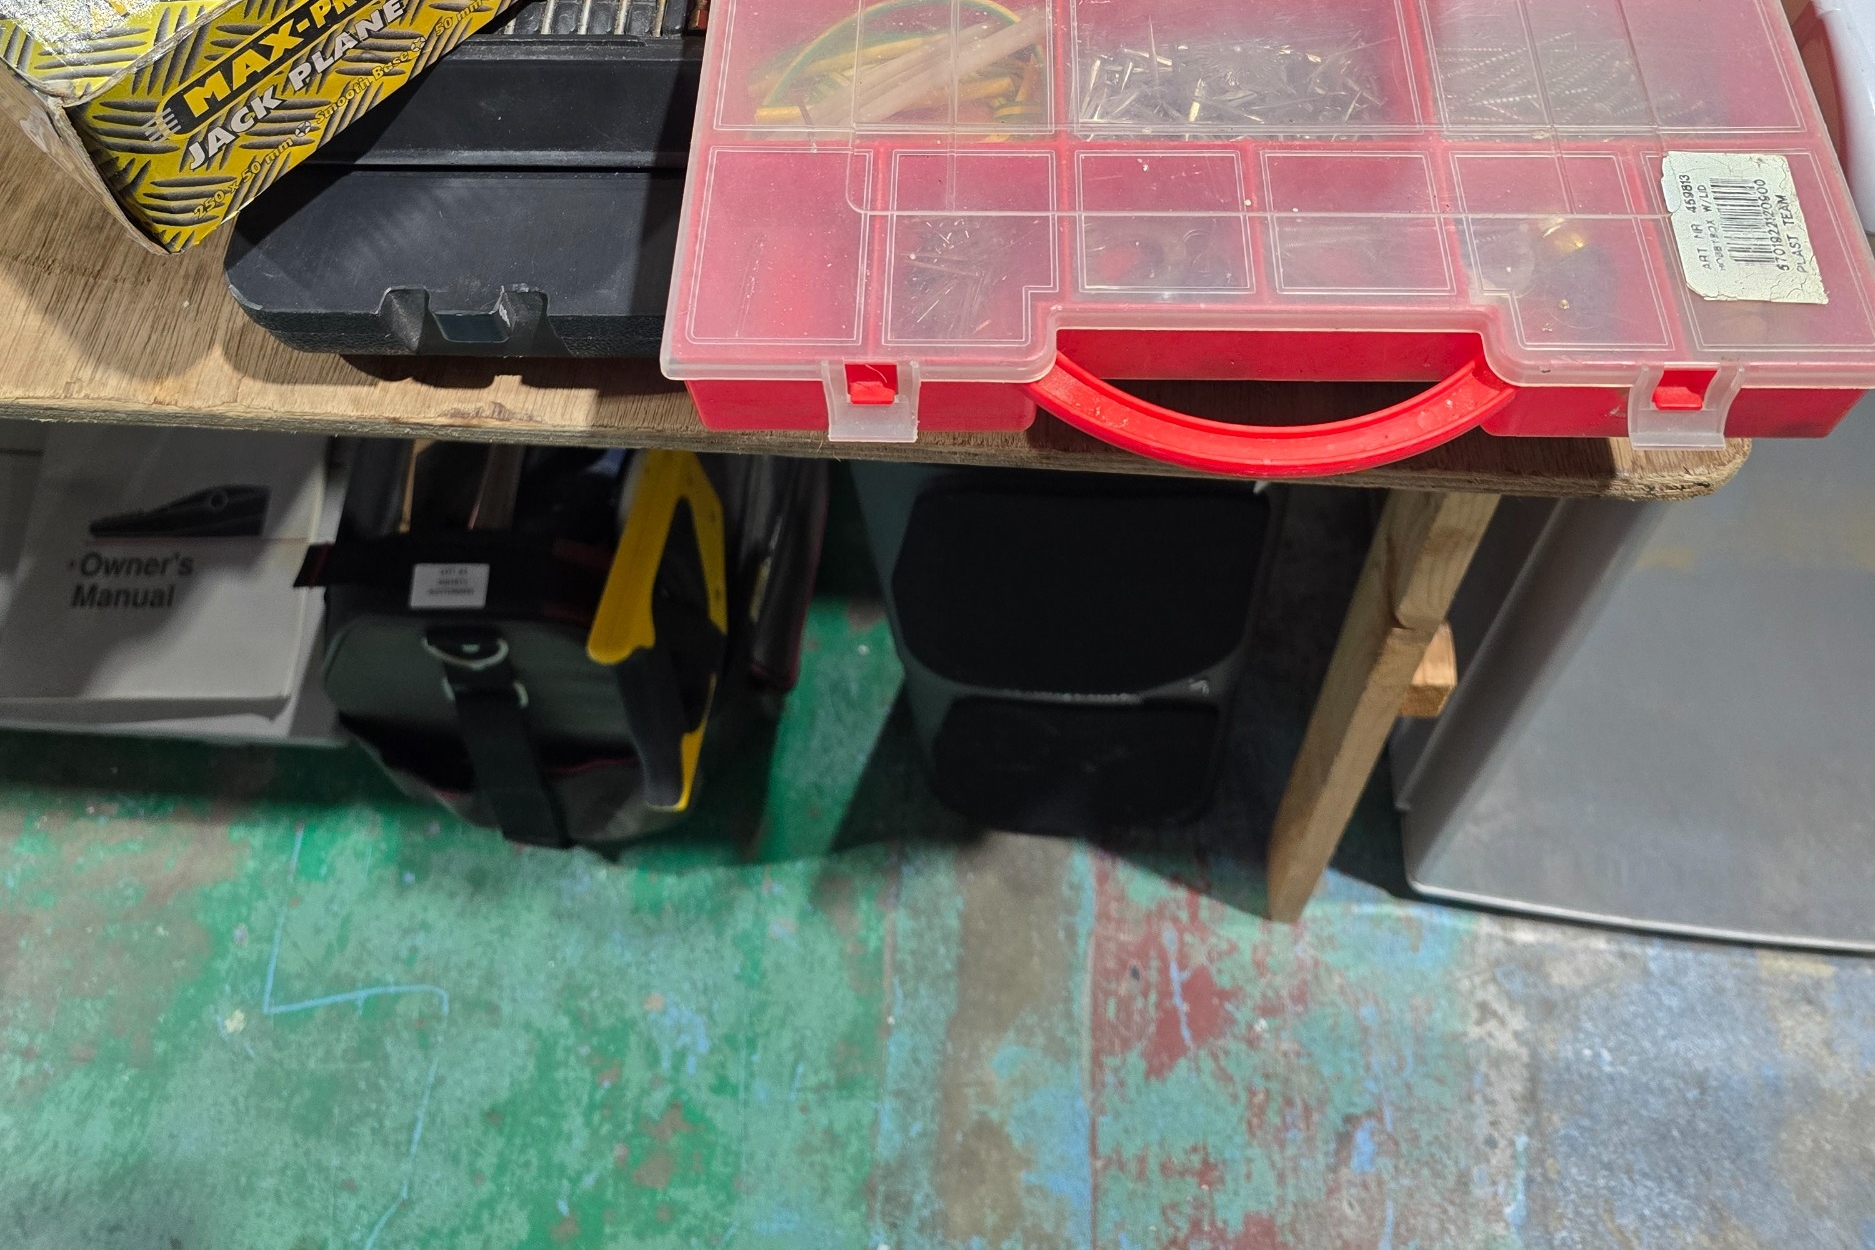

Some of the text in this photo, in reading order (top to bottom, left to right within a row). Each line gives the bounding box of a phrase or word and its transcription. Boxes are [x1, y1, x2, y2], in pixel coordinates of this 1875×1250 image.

[188, 85, 284, 170] JACK
[193, 188, 226, 220] 250
[226, 179, 240, 196] x
[242, 161, 262, 184] 50
[264, 137, 294, 165] mm
[314, 73, 373, 125] Smooth
[371, 50, 409, 82] Base
[434, 15, 456, 37] 50
[1679, 173, 1697, 214] 459813
[1774, 193, 1810, 274] PLAST TEAM
[1697, 247, 1712, 271] ART
[80, 551, 195, 577] Owner's
[71, 582, 177, 608] Manual
